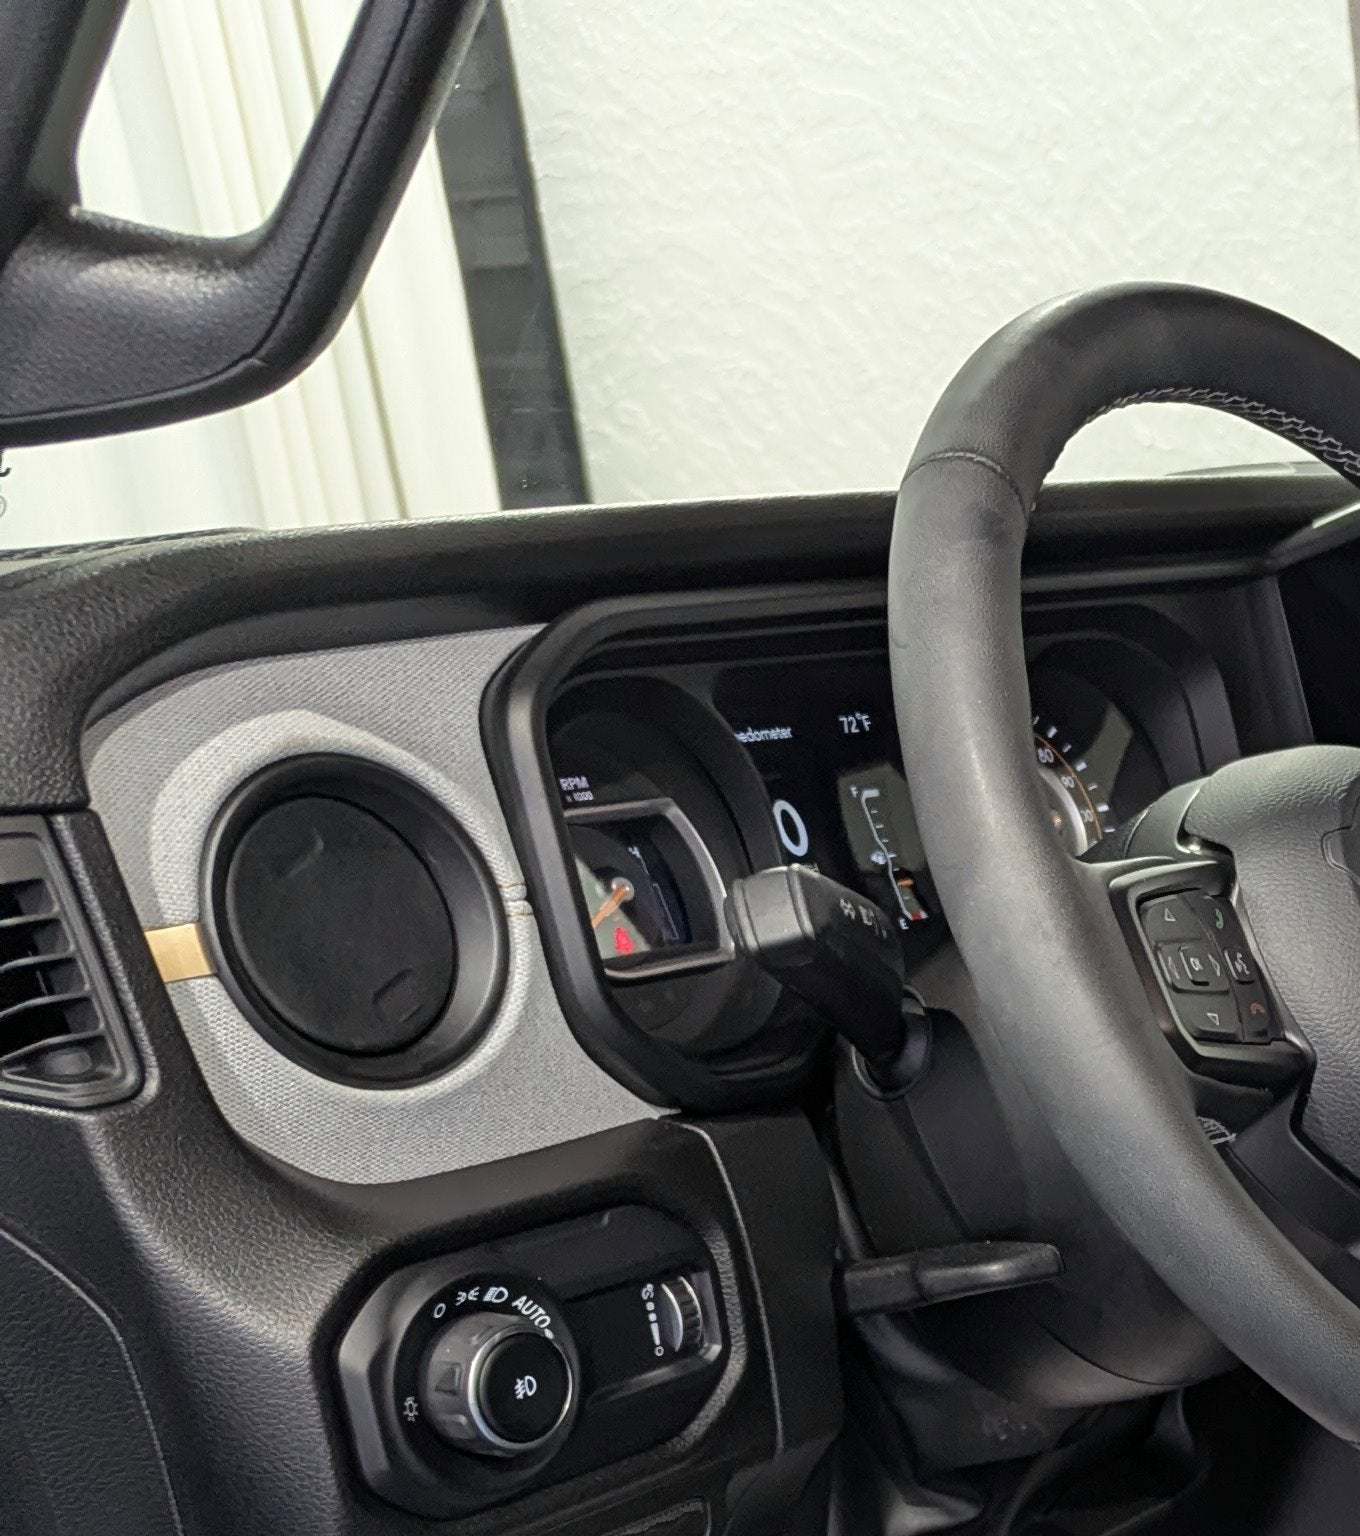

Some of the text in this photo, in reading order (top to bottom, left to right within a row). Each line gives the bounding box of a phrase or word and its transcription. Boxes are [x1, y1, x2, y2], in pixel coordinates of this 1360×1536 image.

[560, 776, 589, 791] RPM
[772, 798, 809, 857] 0
[511, 1294, 552, 1329] AUTO
